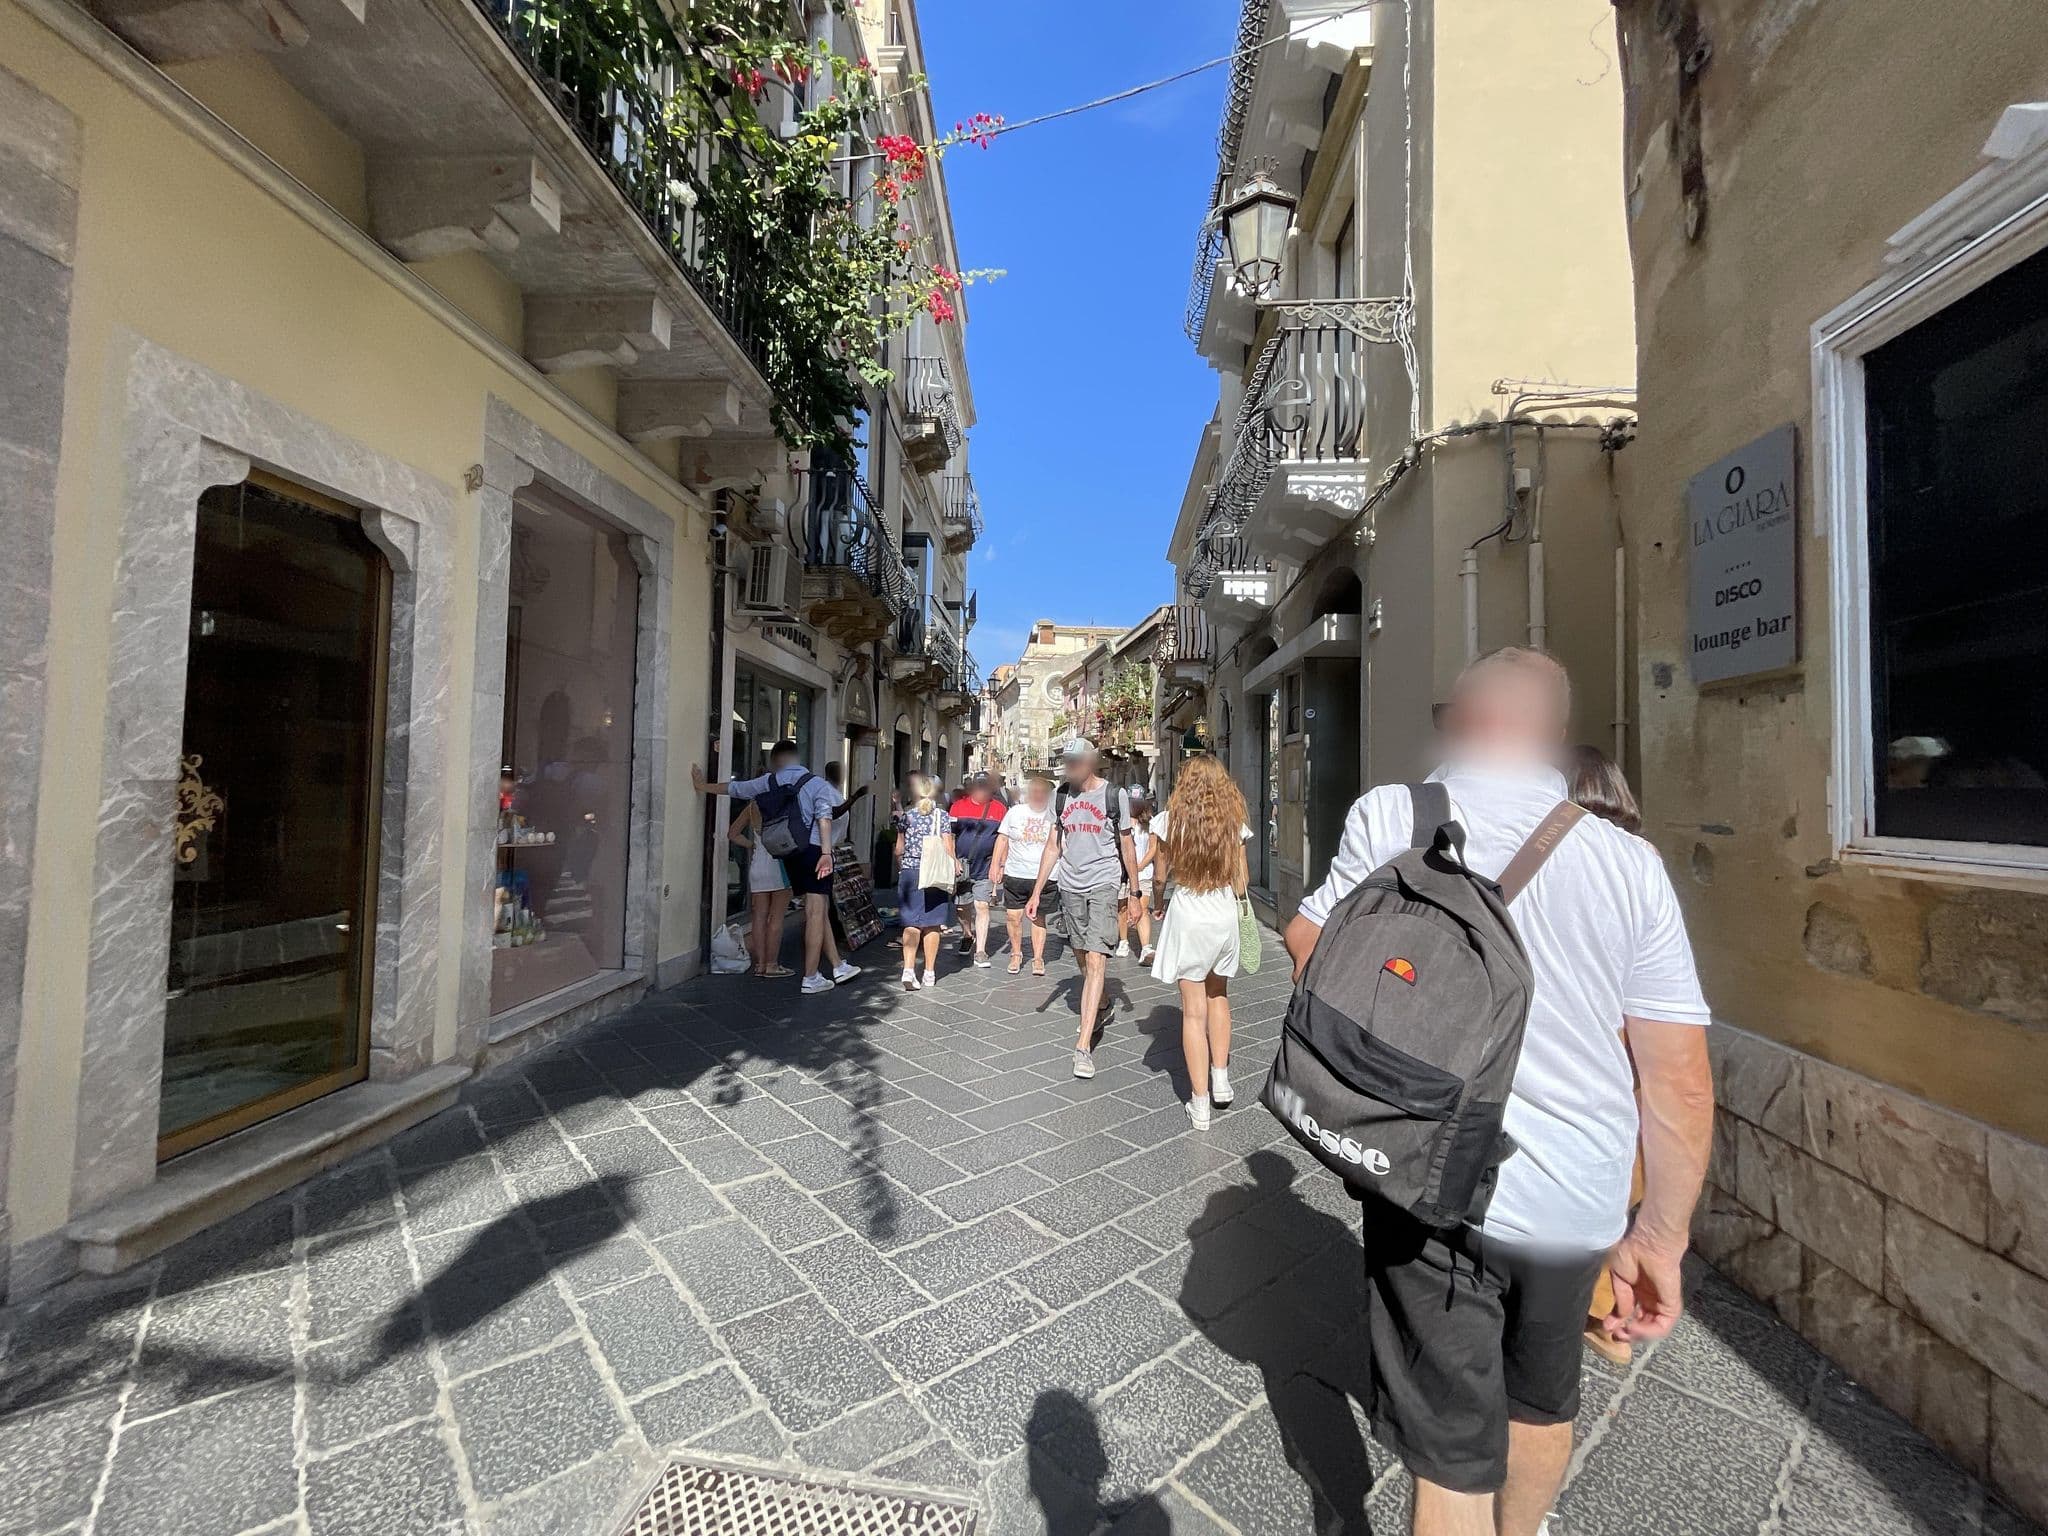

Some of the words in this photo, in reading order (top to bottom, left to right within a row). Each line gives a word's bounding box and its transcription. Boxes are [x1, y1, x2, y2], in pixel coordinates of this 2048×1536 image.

[1694, 514, 1714, 546] LA
[1715, 579, 1762, 607] DISCO
[1693, 626, 1751, 653] lounge
[1756, 615, 1791, 637] bar
[1079, 824, 1101, 834] TAVERN
